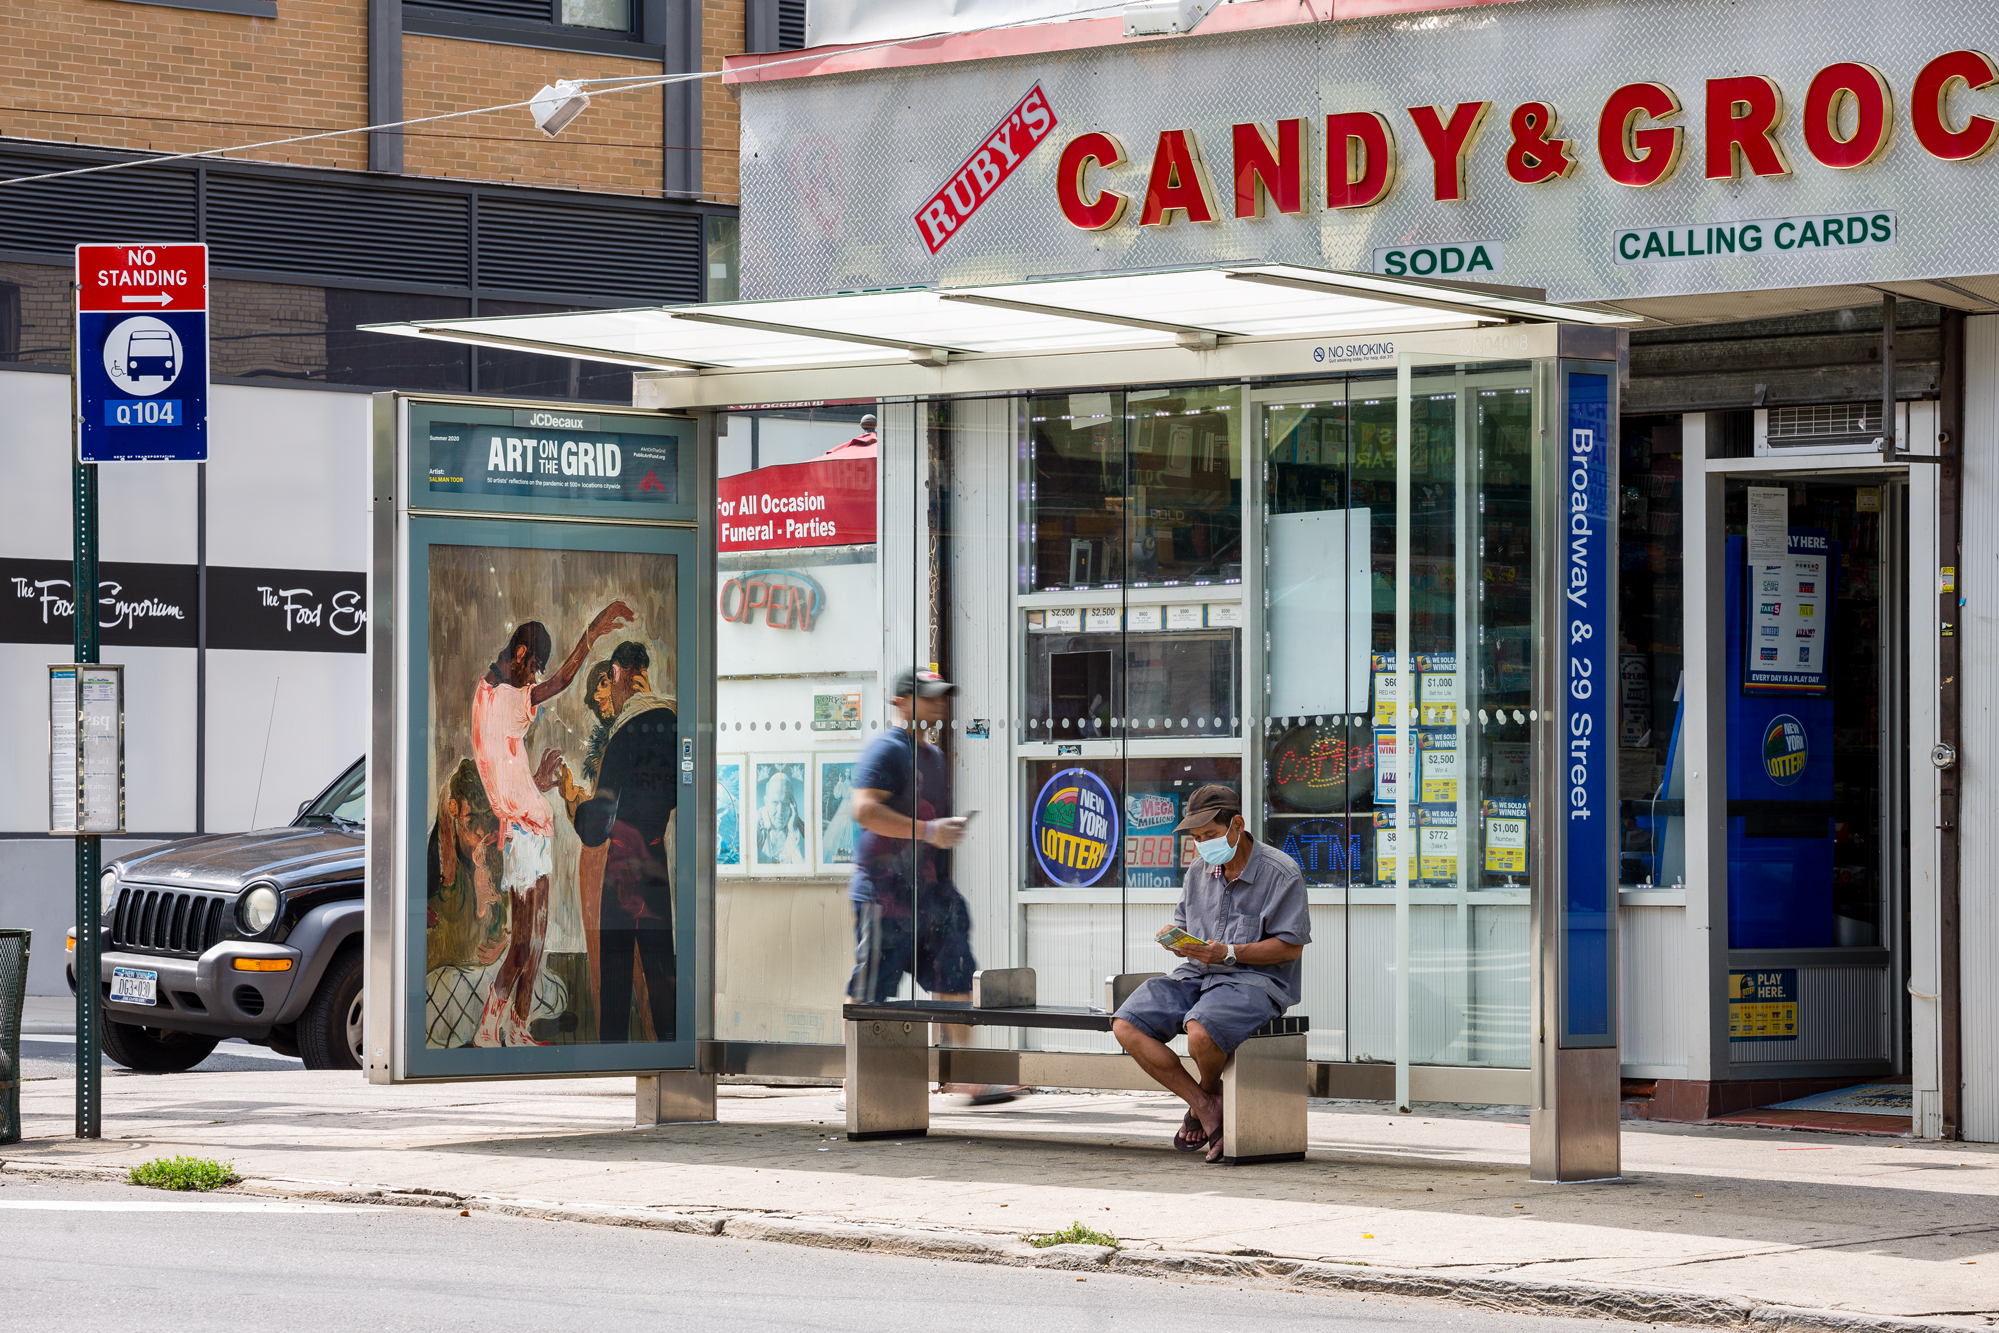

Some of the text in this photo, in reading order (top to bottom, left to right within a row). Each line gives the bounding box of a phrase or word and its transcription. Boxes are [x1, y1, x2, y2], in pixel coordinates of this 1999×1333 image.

[1056, 49, 1999, 231] CANDY & GROC
[919, 88, 1052, 247] RUBY'S
[1619, 213, 1892, 261] CALLING CARDS
[128, 249, 156, 267] NO
[1384, 245, 1494, 277] SODA
[97, 269, 188, 287] STANDING
[1328, 342, 1394, 358] NO SMOKING
[116, 401, 174, 425] Q104
[530, 413, 584, 429] JCDecaux
[488, 436, 622, 477] ART ON THE GRID
[739, 495, 758, 516] All
[761, 492, 825, 514] Occasion
[1567, 428, 1593, 608] Broadway
[722, 520, 774, 542] Funeral
[786, 518, 836, 538] Parties
[1788, 535, 1828, 549] AY HERE.
[11, 577, 36, 599] The
[257, 586, 280, 607] The
[279, 588, 323, 632] Food
[720, 579, 814, 632] OPEN
[1052, 608, 1075, 618] $2,500
[1092, 608, 1116, 618] $2,500
[1571, 620, 1592, 646] &
[1428, 678, 1452, 688] $1,000
[1571, 658, 1592, 700] 29
[1784, 723, 1799, 734] NEW
[1786, 735, 1804, 752] YORK
[1428, 755, 1454, 765] $2,500
[1570, 712, 1592, 820] Street
[1767, 750, 1806, 777] LOTTERY
[1080, 788, 1104, 816] NEW
[1140, 799, 1174, 818] MEGA
[1079, 808, 1108, 840] YORK
[1138, 816, 1174, 828] MILLIONS
[1493, 823, 1519, 834] $1,000
[1429, 831, 1448, 840] $772
[1042, 826, 1108, 870] LOTTERY
[1282, 834, 1360, 870] ATM
[1126, 872, 1171, 888] Million
[1758, 974, 1782, 985] PLAY
[1758, 986, 1786, 998] HERE.
